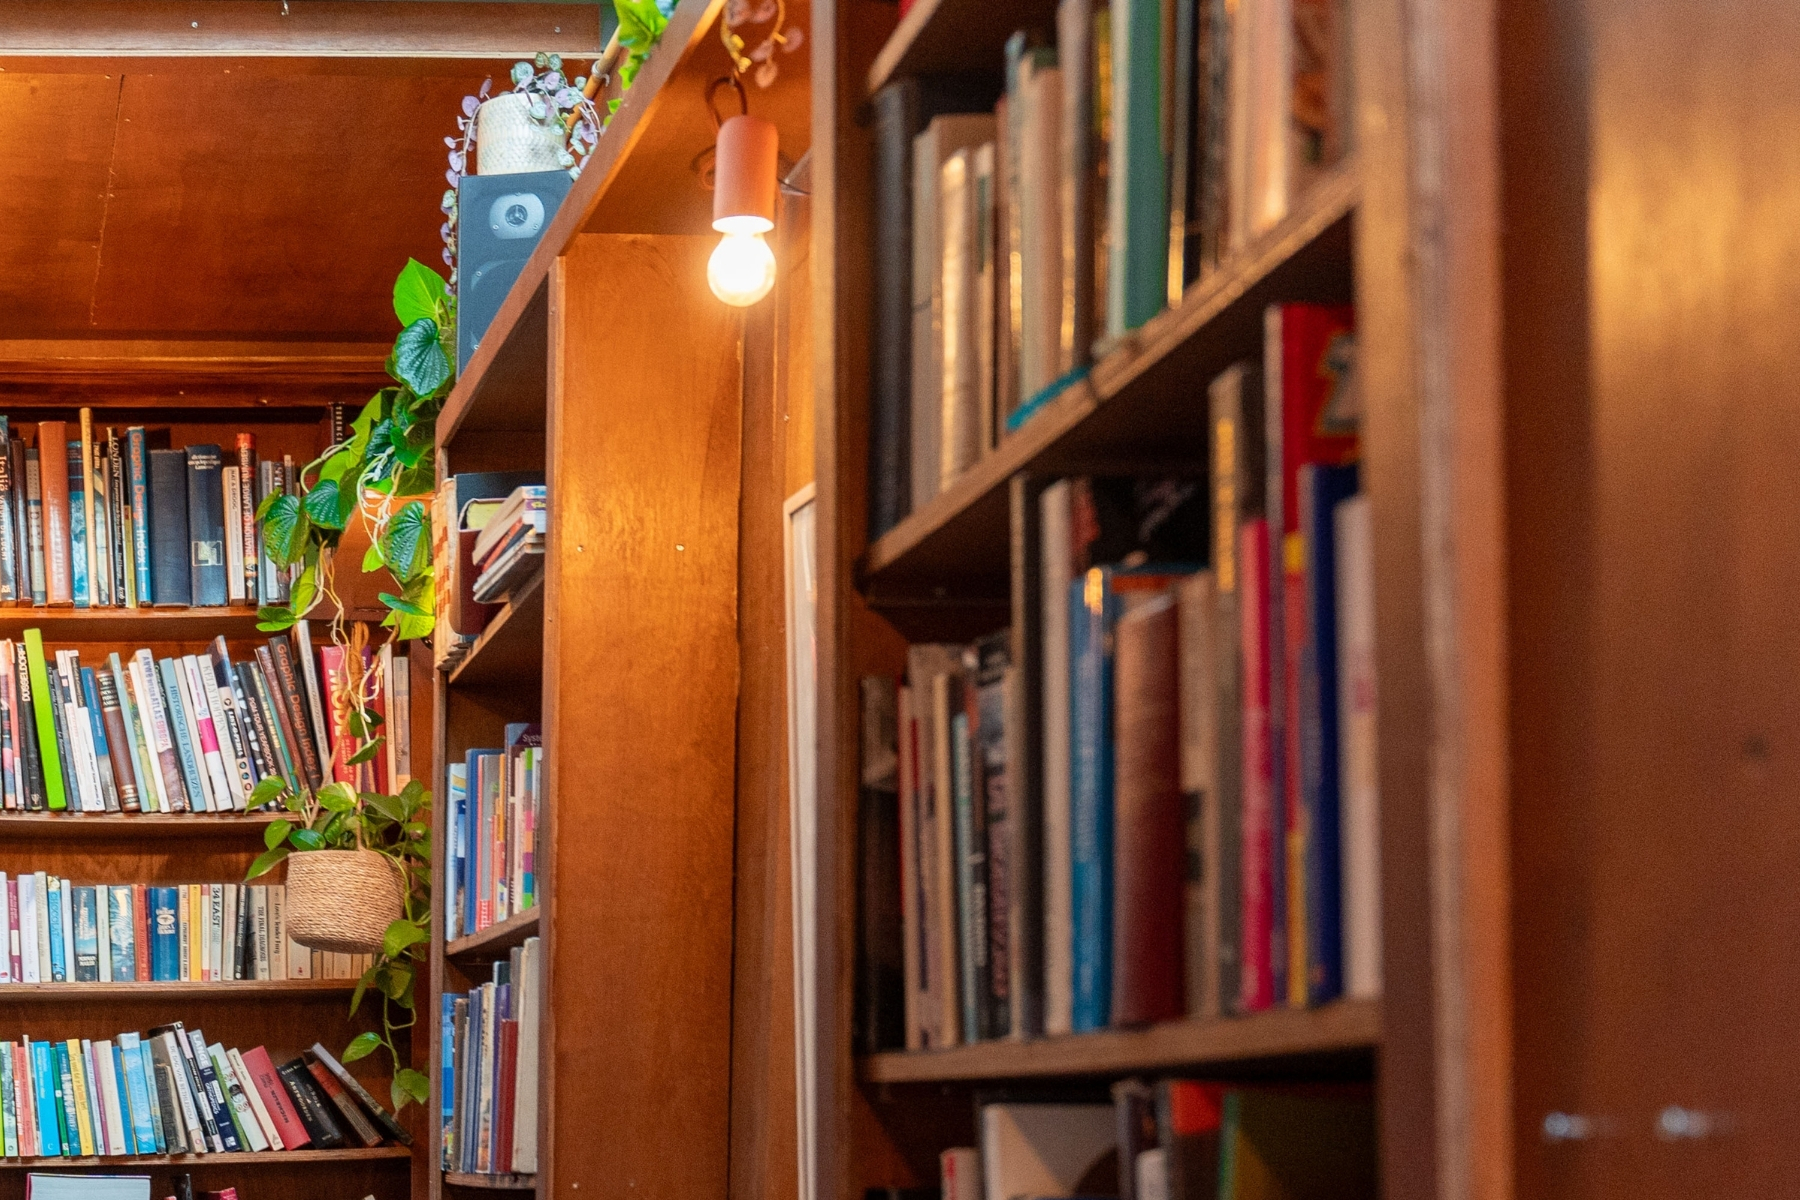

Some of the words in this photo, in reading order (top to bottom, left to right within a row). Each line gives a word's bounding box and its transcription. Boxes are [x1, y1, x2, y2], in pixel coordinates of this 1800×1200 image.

[111, 437, 120, 478] LONDEN
[131, 432, 144, 480] Graphic
[241, 443, 250, 482] NUMBERS
[133, 485, 146, 526] Design
[242, 483, 251, 509] LARGE
[135, 530, 147, 562] Index
[151, 698, 163, 721] ATLAS
[201, 667, 214, 692] KELLY
[208, 694, 224, 733] HOPPEN
[276, 645, 296, 692] Graphic
[287, 696, 307, 737] Design
[299, 740, 315, 771] Index
[156, 722, 168, 750] EUROPA
[169, 686, 187, 742] HISTORISCHE
[179, 743, 200, 801] LANDHUIZEN
[212, 888, 220, 899] 34
[48, 892, 59, 938] CHOCOLAT
[211, 901, 220, 928] EAST
[257, 907, 265, 917] THE
[258, 917, 266, 934] FINAL
[171, 1056, 179, 1069] DAG
[192, 1034, 209, 1067] LANGE
[175, 1070, 184, 1082] VAN
[178, 1083, 194, 1121] BETHLEHEM
[269, 1089, 290, 1124] MICHELIN
